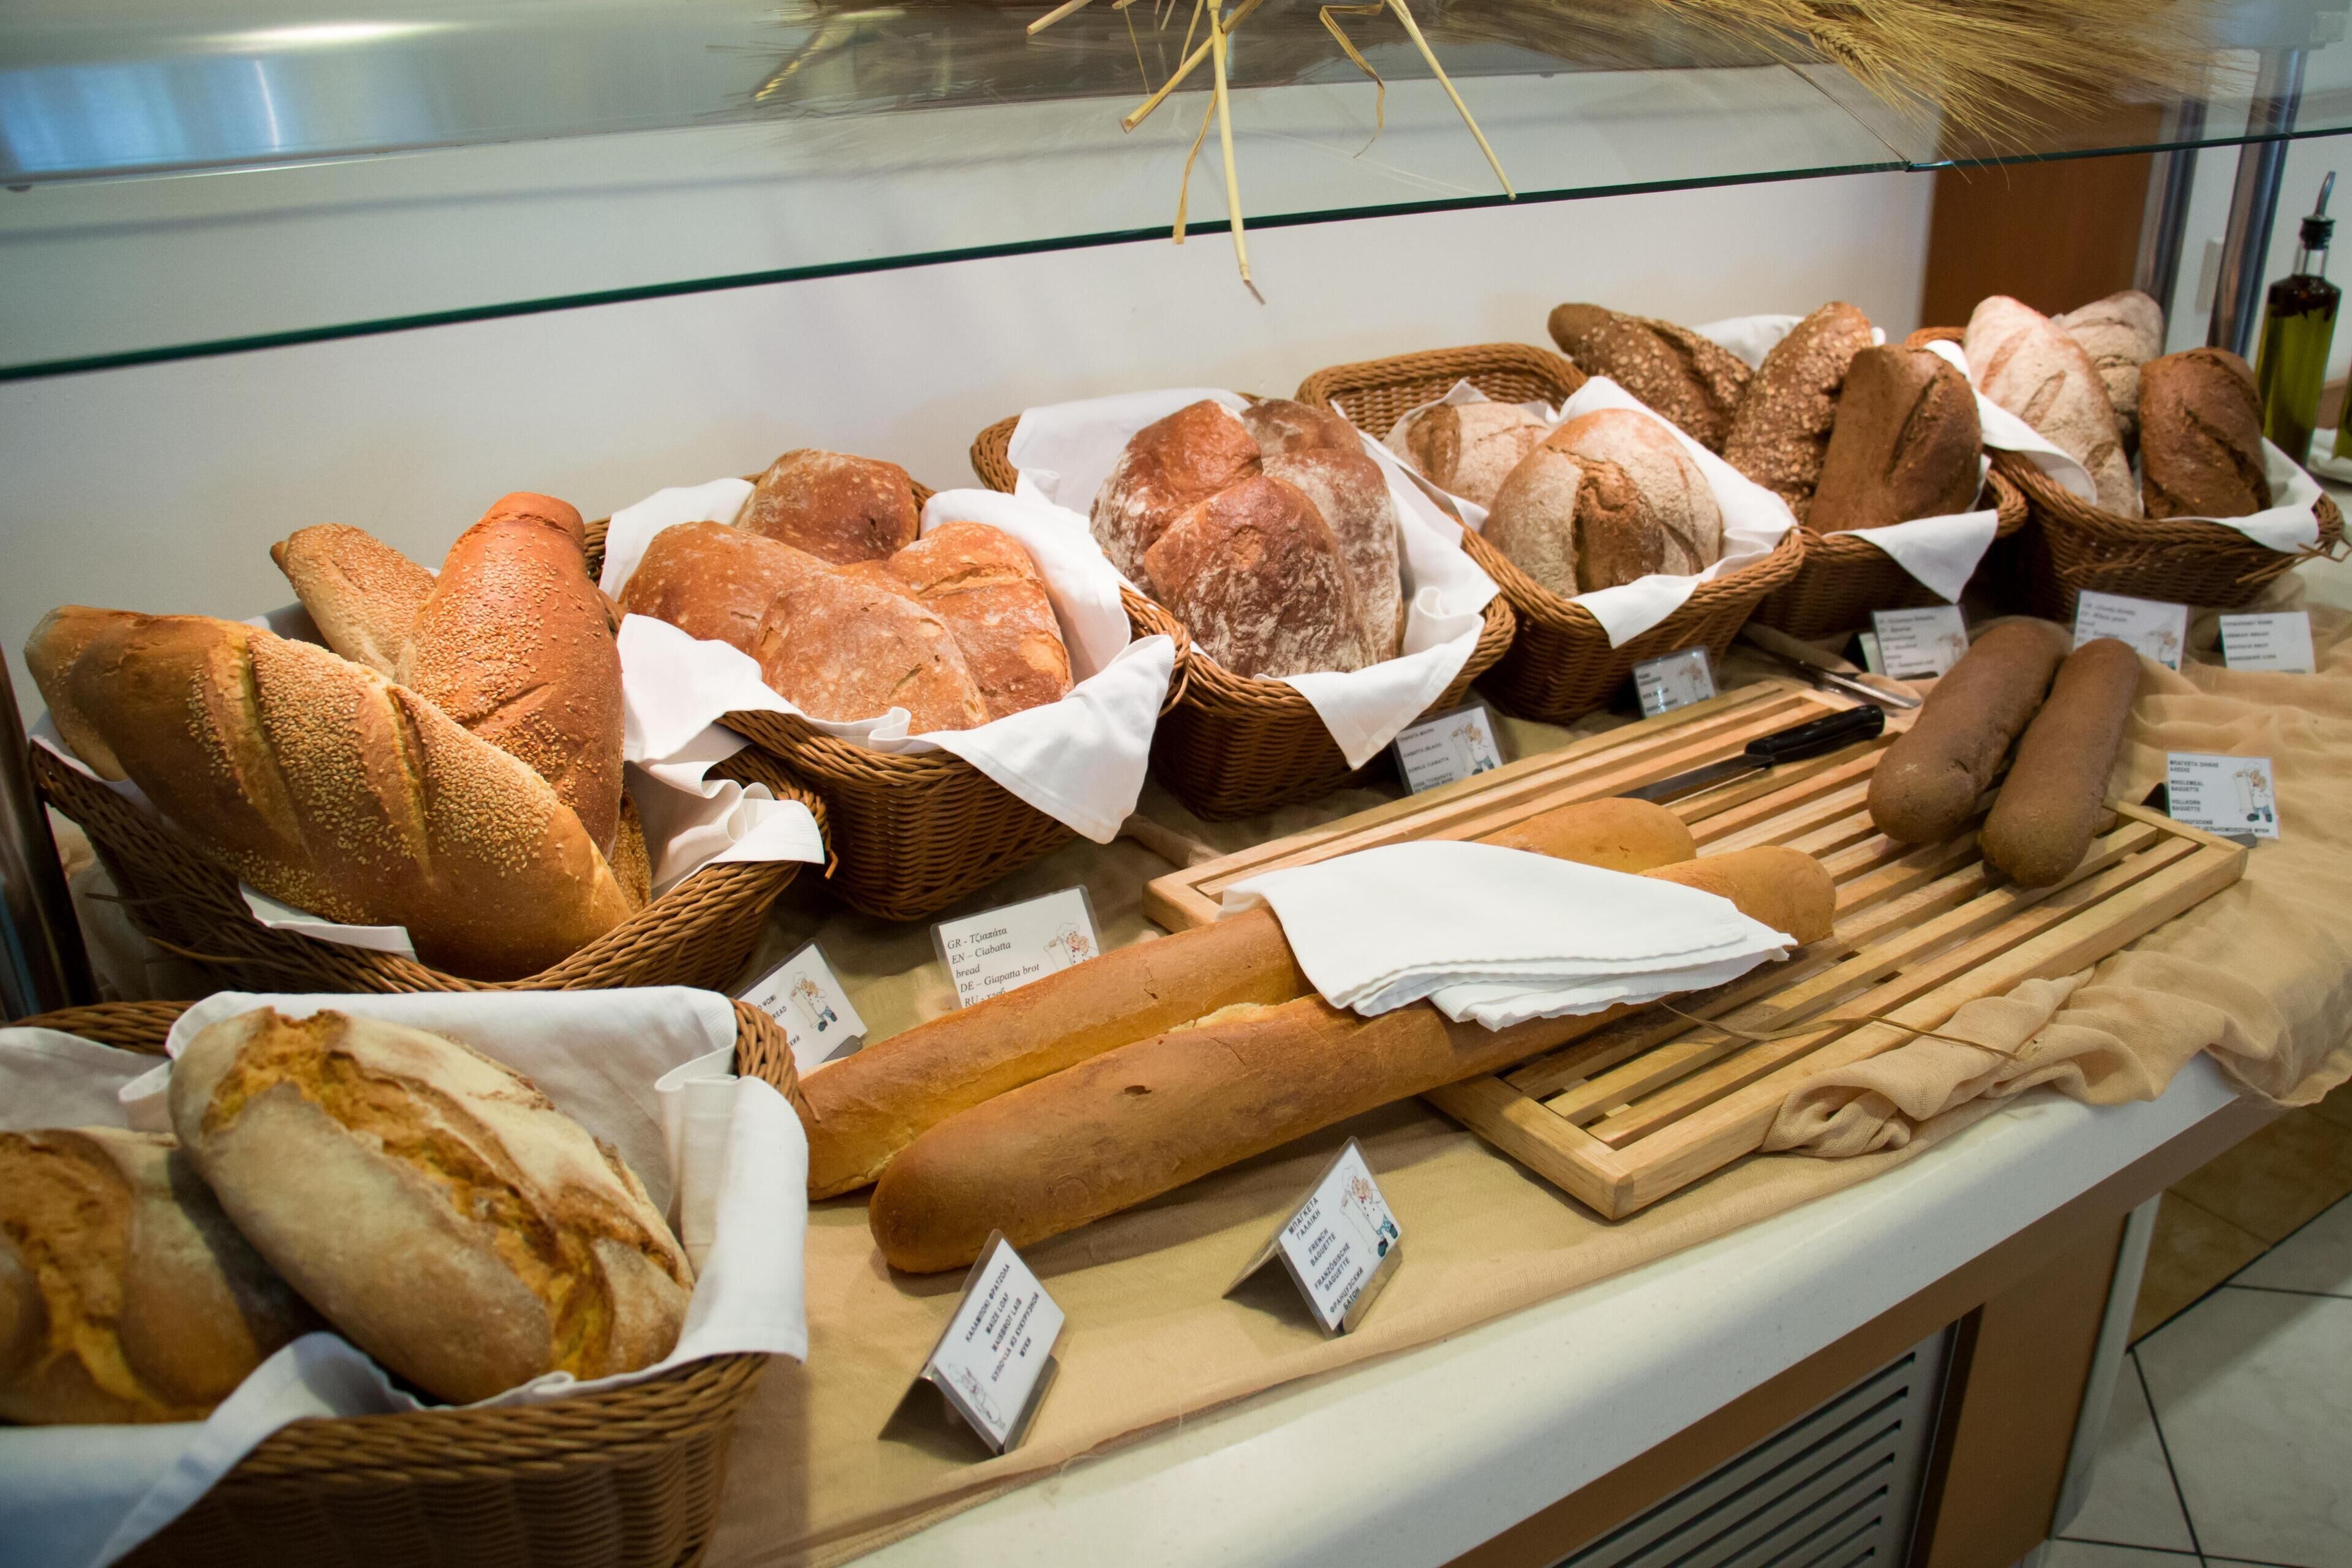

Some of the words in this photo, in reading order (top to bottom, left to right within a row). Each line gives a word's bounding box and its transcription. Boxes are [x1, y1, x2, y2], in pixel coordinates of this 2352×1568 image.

[948, 938, 961, 949] GR
[970, 927, 1007, 944] Τζιαπάτα
[952, 954, 965, 964] EN
[975, 942, 1011, 957] Ciabatta
[956, 965, 980, 978] bread
[960, 981, 974, 993] DE
[984, 970, 1020, 986] Giapatta
[1023, 963, 1039, 974] brot
[772, 1006, 787, 1020] READ
[965, 995, 978, 1007] RU
[1288, 1197, 1319, 1235] ΜΠΑΓΚΕΤΑ
[1297, 1210, 1321, 1240] ΓΑΛΛΙΚΗ
[1308, 1227, 1329, 1254] FRENCH
[1310, 1234, 1336, 1267] BAGUETTE
[1314, 1243, 1351, 1289] FRANZÖSISCHE
[1325, 1258, 1350, 1291] BAGUETTE
[1330, 1267, 1363, 1313] ФРАНЦУЗСКИЙ
[1344, 1287, 1360, 1310] БАТОН
[985, 1314, 1000, 1335] MAIZE
[997, 1293, 1009, 1316] LOAF
[992, 1314, 1014, 1352] MAISBROT
[1011, 1297, 1022, 1316] LAIB
[1016, 1291, 1040, 1337] КУКУРУЗНОЙ
[1019, 1336, 1031, 1357] МУКИ
